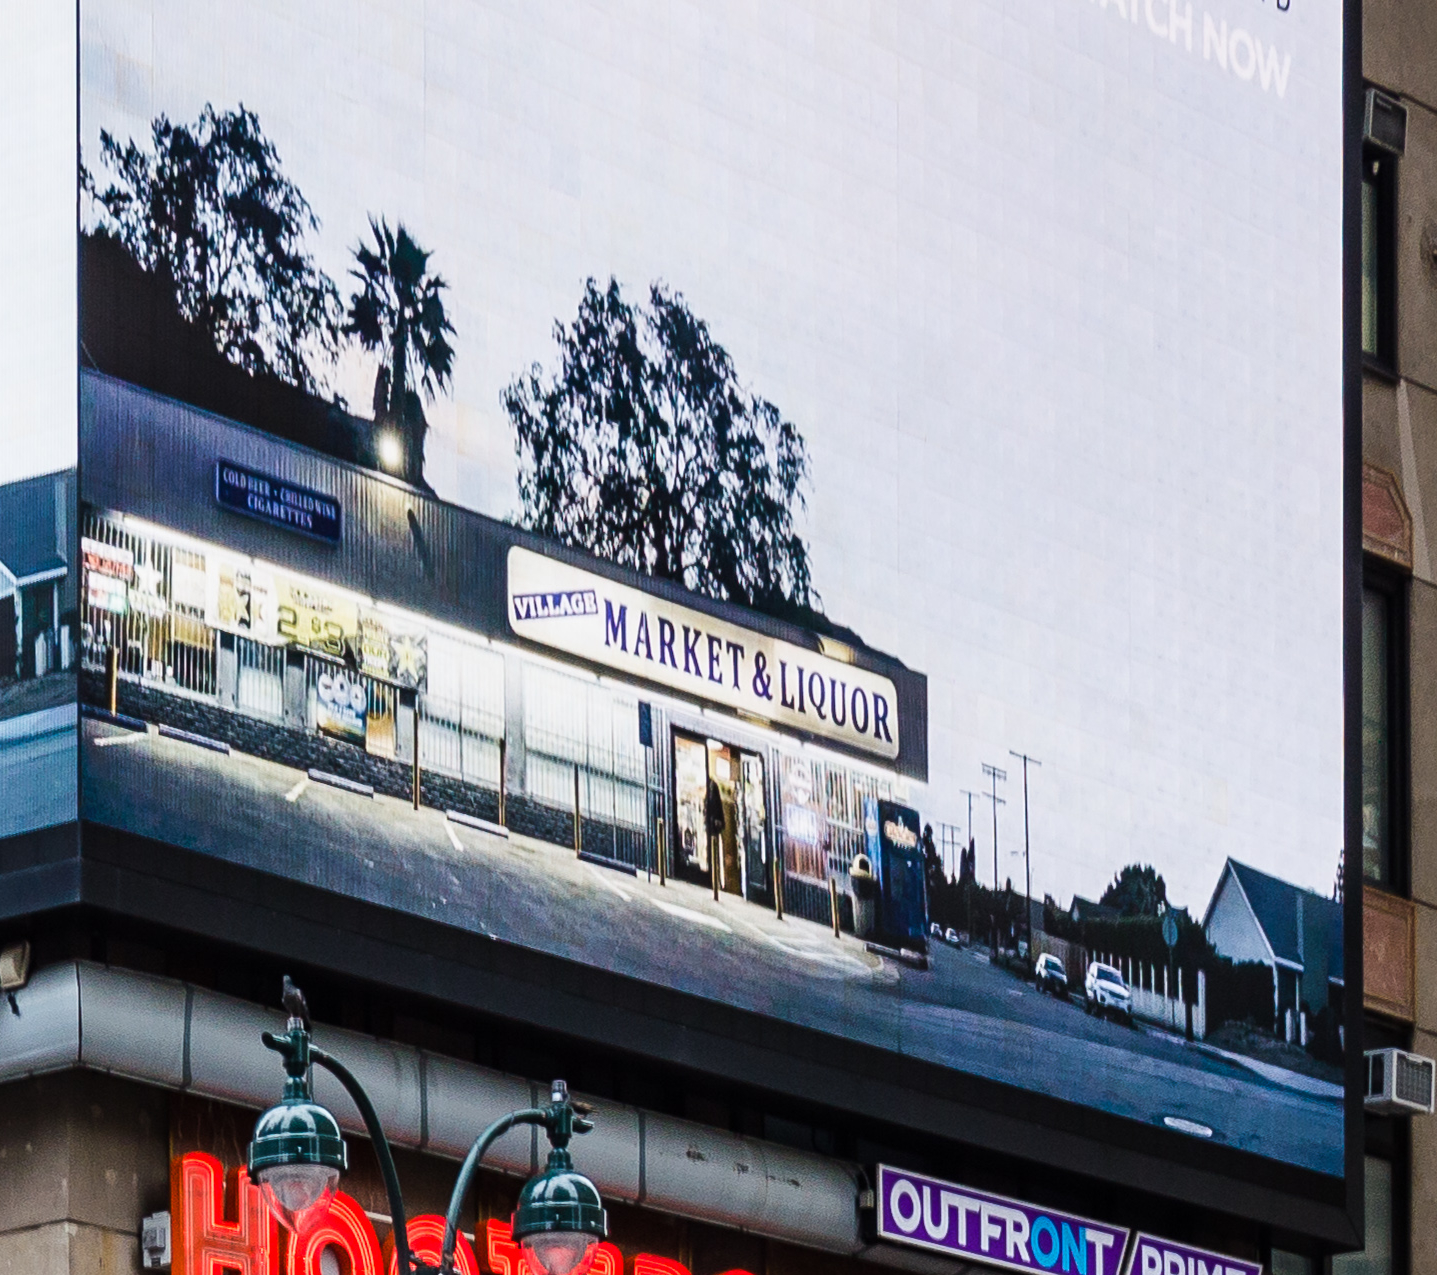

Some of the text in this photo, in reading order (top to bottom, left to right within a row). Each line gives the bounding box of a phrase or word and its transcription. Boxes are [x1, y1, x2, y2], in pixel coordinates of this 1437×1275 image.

[1203, 11, 1291, 99] NOW
[510, 587, 896, 744] VILLAGE MARKET & LIQUOR
